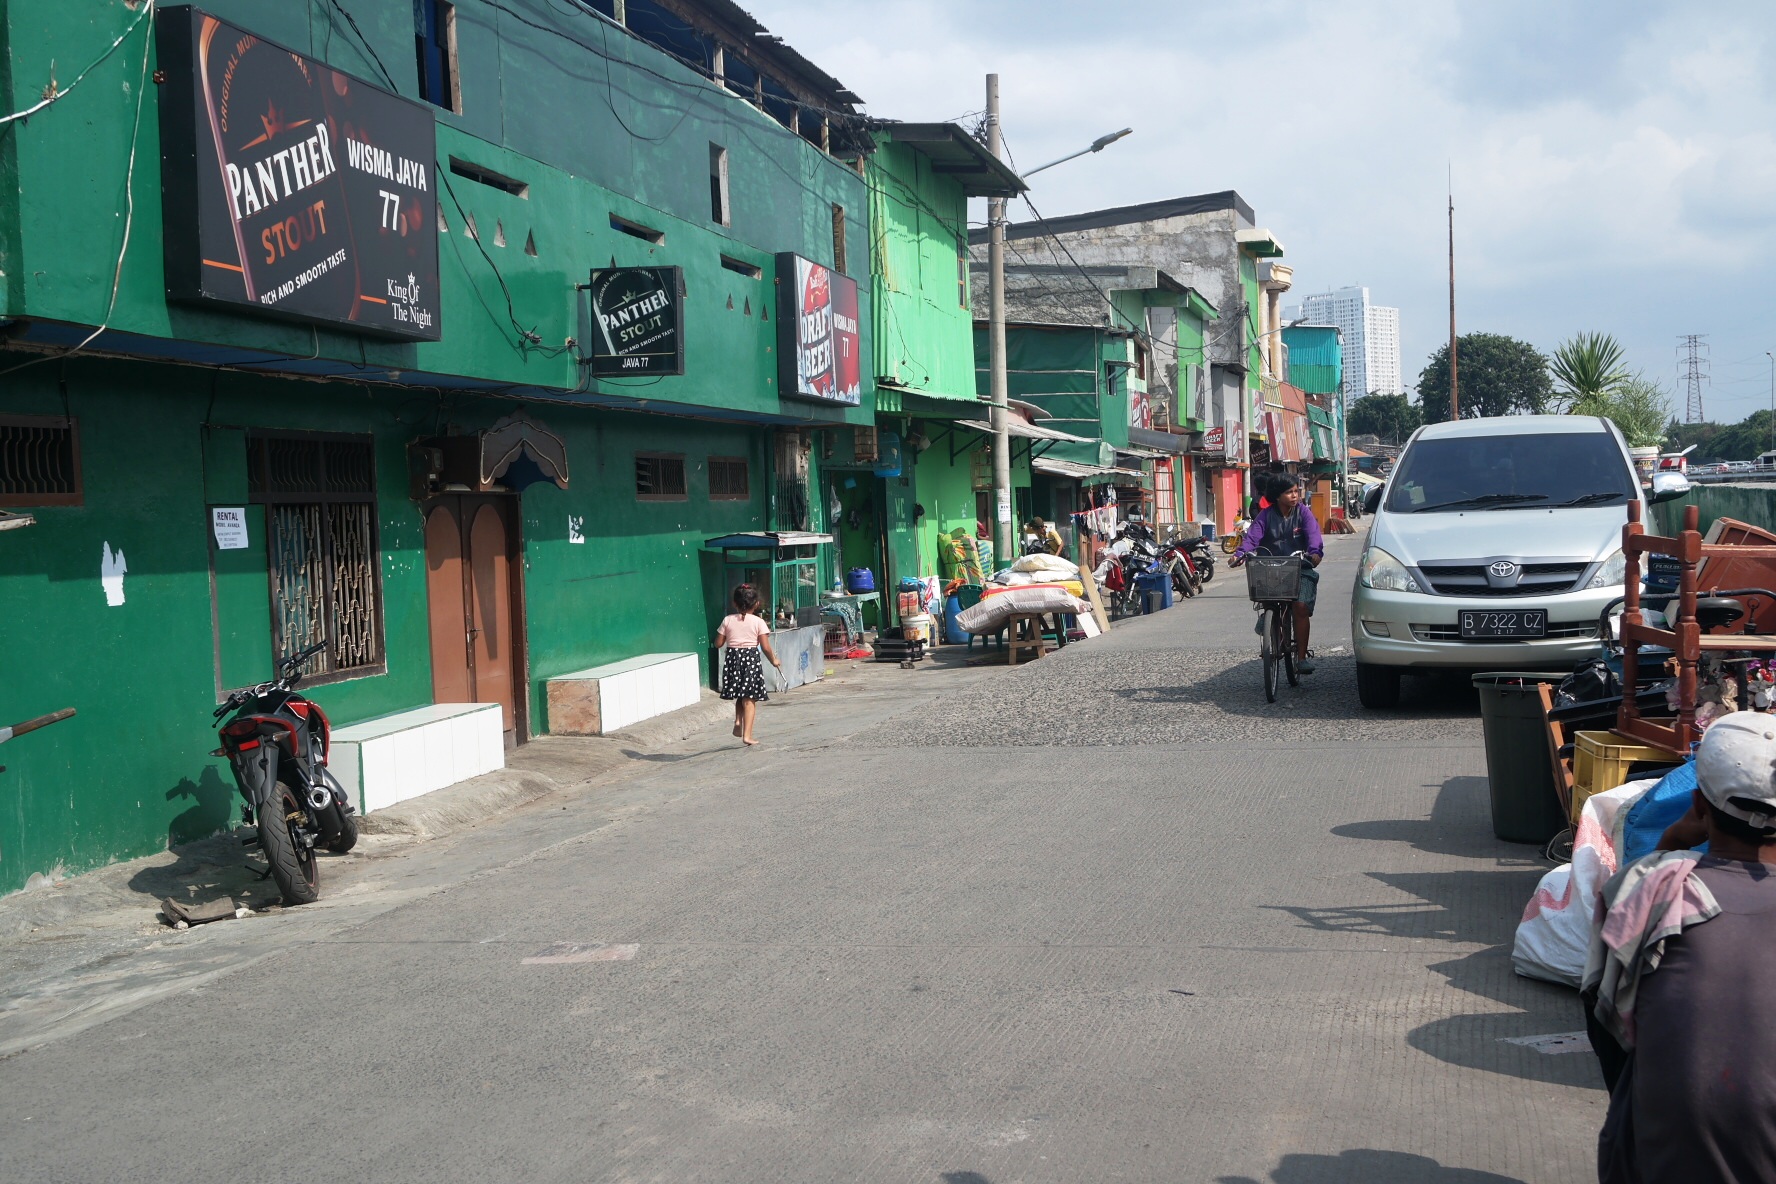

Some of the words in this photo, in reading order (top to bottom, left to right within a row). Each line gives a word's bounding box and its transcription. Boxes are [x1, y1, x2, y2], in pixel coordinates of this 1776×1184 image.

[221, 53, 239, 133] ORIGINAL
[226, 122, 336, 220] PANTHER
[347, 138, 394, 180] WISMA
[396, 156, 427, 192] JAYA
[379, 189, 400, 231] 77
[261, 200, 326, 265] STOUT
[278, 280, 295, 300] AND
[295, 260, 328, 289] SMOOTH
[327, 248, 346, 269] TASTE
[387, 278, 408, 303] King
[408, 282, 420, 302] Of
[392, 302, 408, 322] The
[409, 305, 432, 329] Night
[600, 289, 669, 332] PANTHER
[620, 315, 661, 342] STOUT
[801, 303, 831, 345] DRAFT
[622, 357, 640, 368] JAVA
[641, 357, 649, 368] 77
[629, 343, 640, 352] AND
[639, 334, 662, 347] SMOOTH
[805, 338, 831, 378] BEER
[842, 337, 849, 358] 77
[216, 511, 239, 521] RENTAL
[1464, 613, 1474, 629] B
[1480, 613, 1517, 628] 7322
[1524, 613, 1542, 628] CZ
